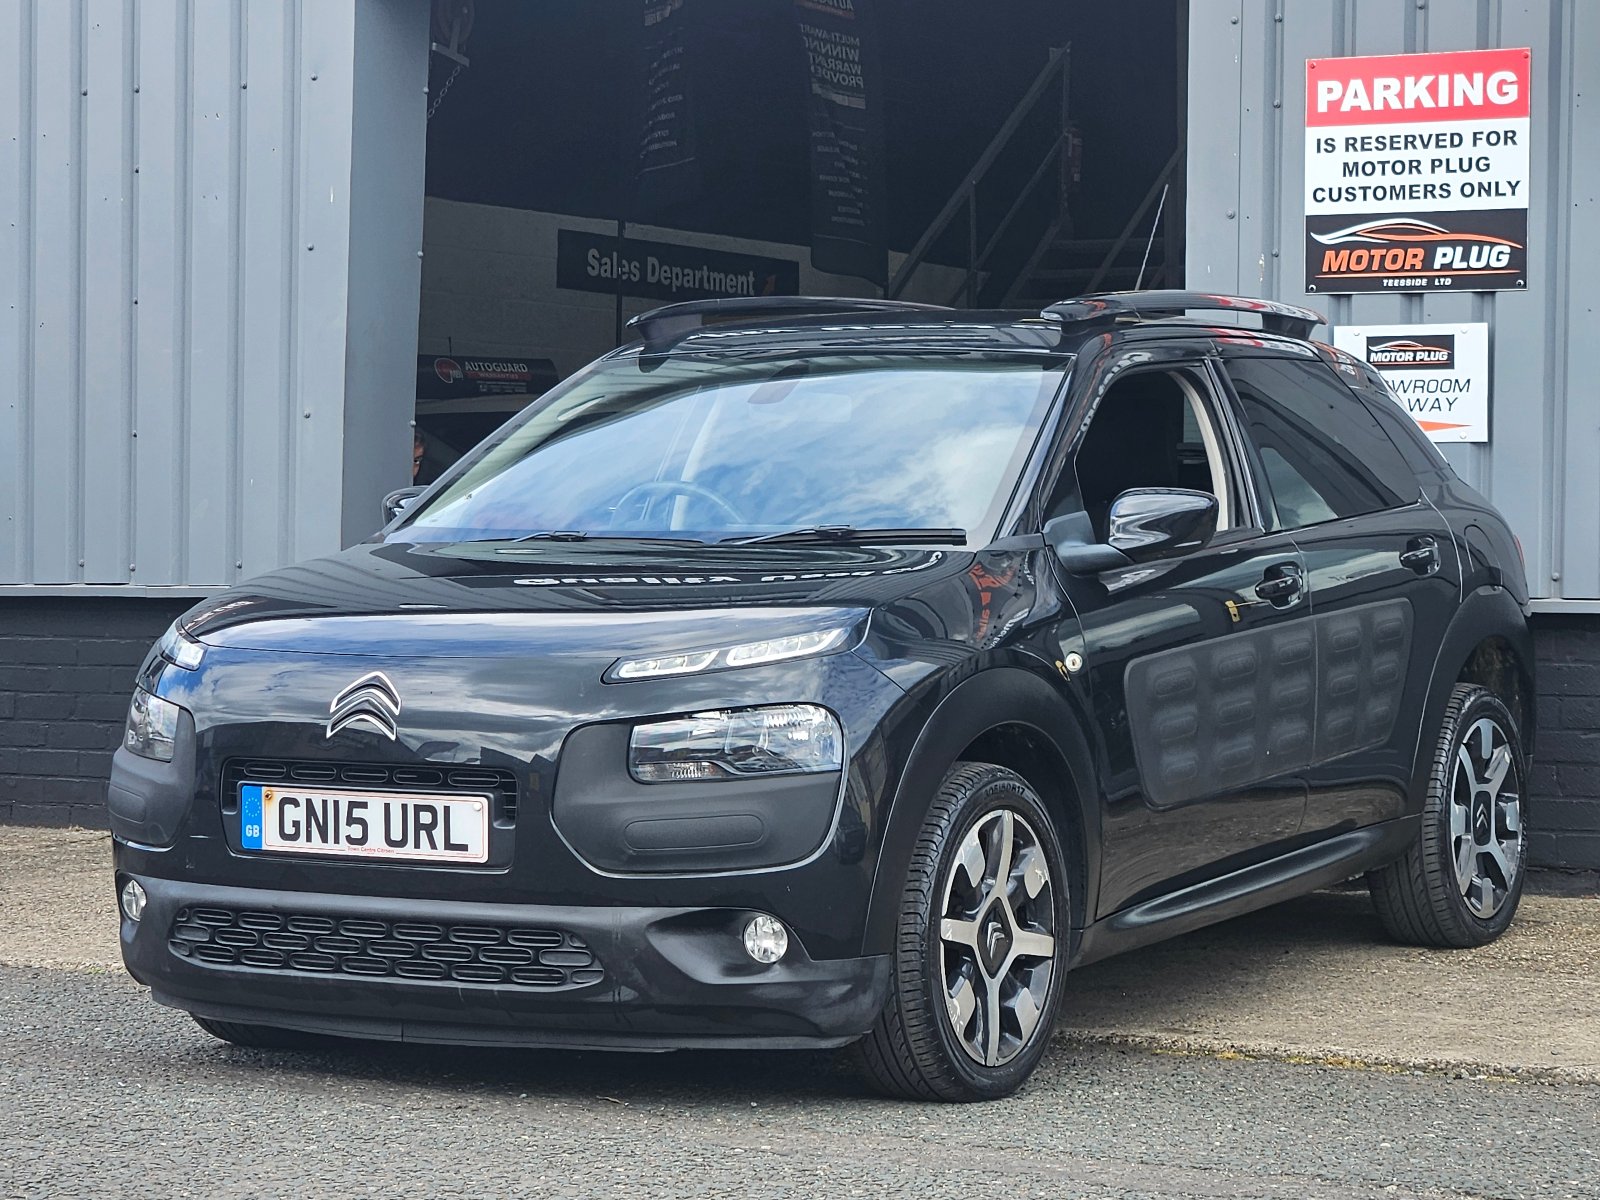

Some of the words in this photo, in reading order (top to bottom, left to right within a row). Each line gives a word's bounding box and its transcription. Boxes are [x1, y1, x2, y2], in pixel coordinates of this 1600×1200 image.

[1317, 71, 1519, 113] PARKING
[1316, 137, 1336, 153] IS
[1344, 132, 1464, 153] RESERVED
[1472, 129, 1518, 148] FOR
[1342, 159, 1422, 178] MOTOR
[1430, 156, 1491, 174] PLUG
[1312, 183, 1452, 203] CUSTOMERS
[1460, 180, 1521, 199] ONLY
[1322, 247, 1425, 272] MOTOR
[1433, 245, 1511, 269] PLUG
[586, 248, 641, 283] Sales
[646, 255, 755, 297] Department
[1382, 278, 1428, 287] TEESSIDE
[1434, 277, 1452, 286] LTD
[465, 361, 528, 373] AUTOGUARD
[1370, 351, 1414, 363] MOTOR
[1415, 351, 1448, 362] PLUG
[1387, 378, 1471, 394] WROOM
[1407, 397, 1458, 412] WAY
[245, 824, 260, 838] GB
[278, 796, 369, 847] GN15
[383, 802, 469, 853] URL
